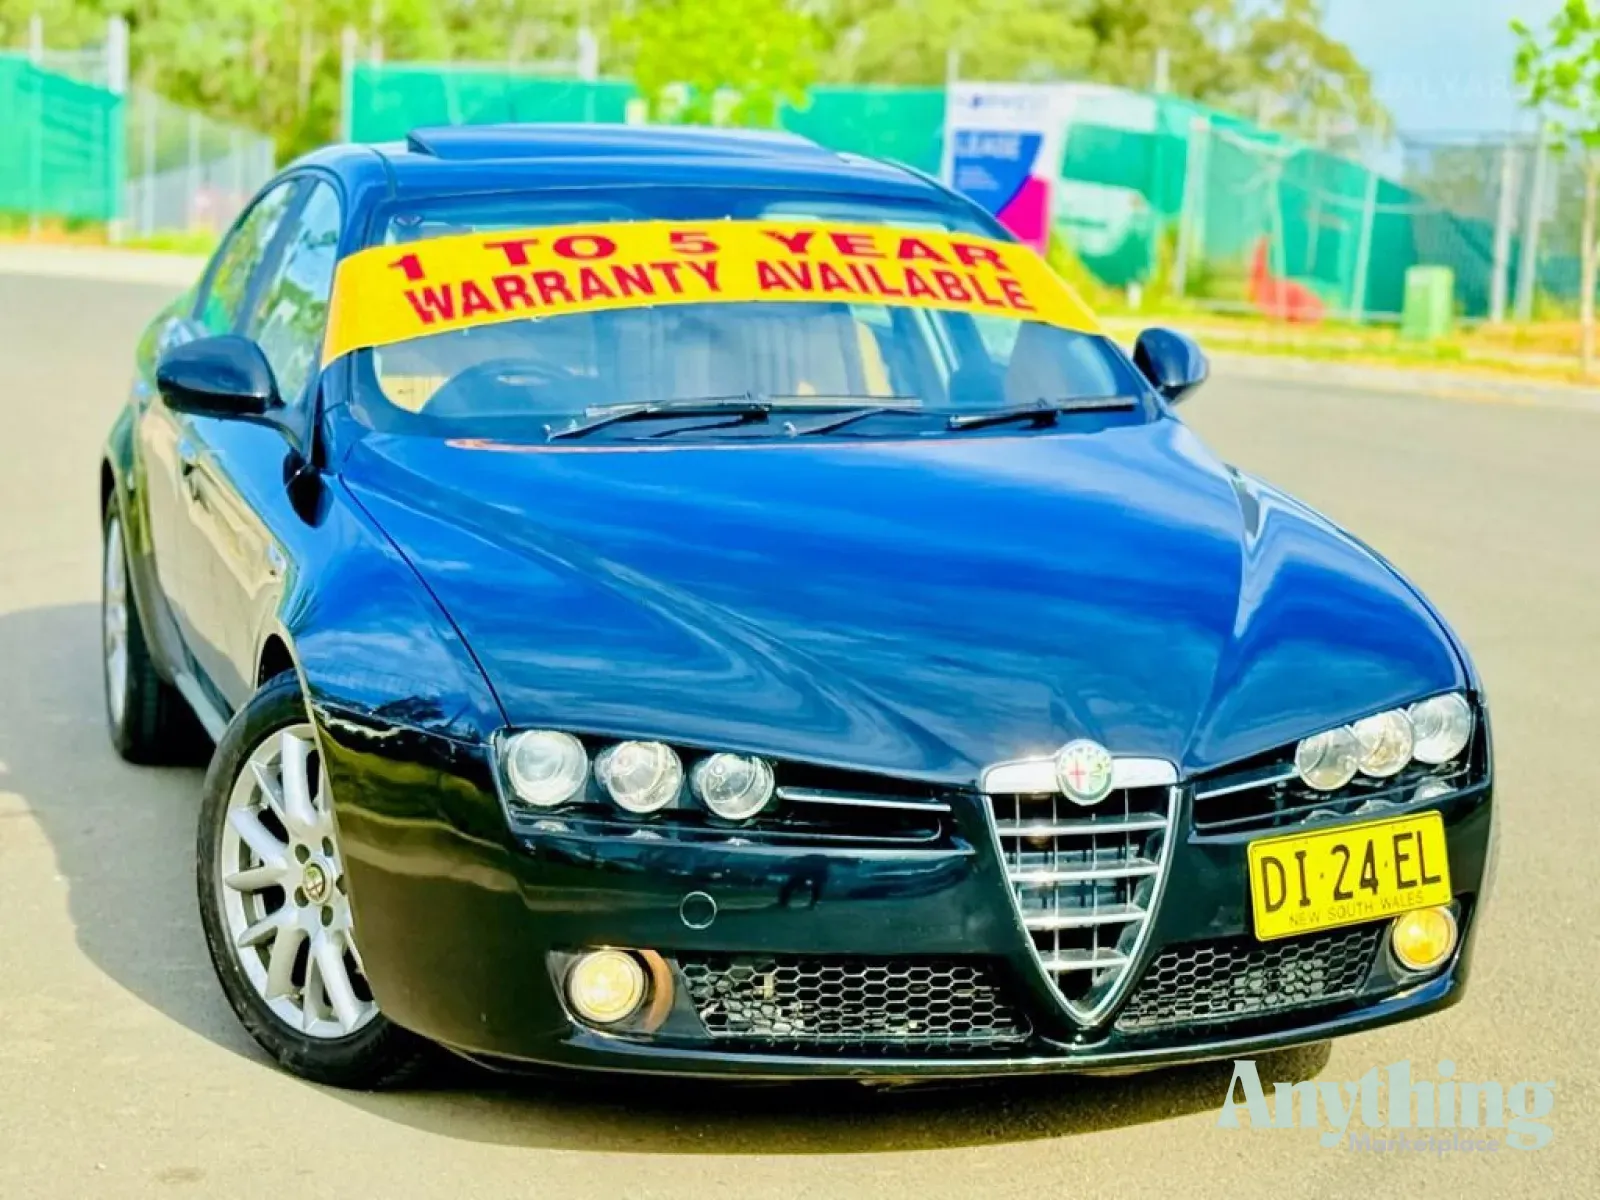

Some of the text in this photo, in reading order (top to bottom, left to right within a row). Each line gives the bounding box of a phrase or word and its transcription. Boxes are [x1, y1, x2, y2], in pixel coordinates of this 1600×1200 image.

[388, 230, 1011, 283] 1 TO 5 YEAR
[404, 260, 1037, 325] WARRANTY AVAILABLE
[1288, 889, 1425, 926] NEW SOUTH WALES
